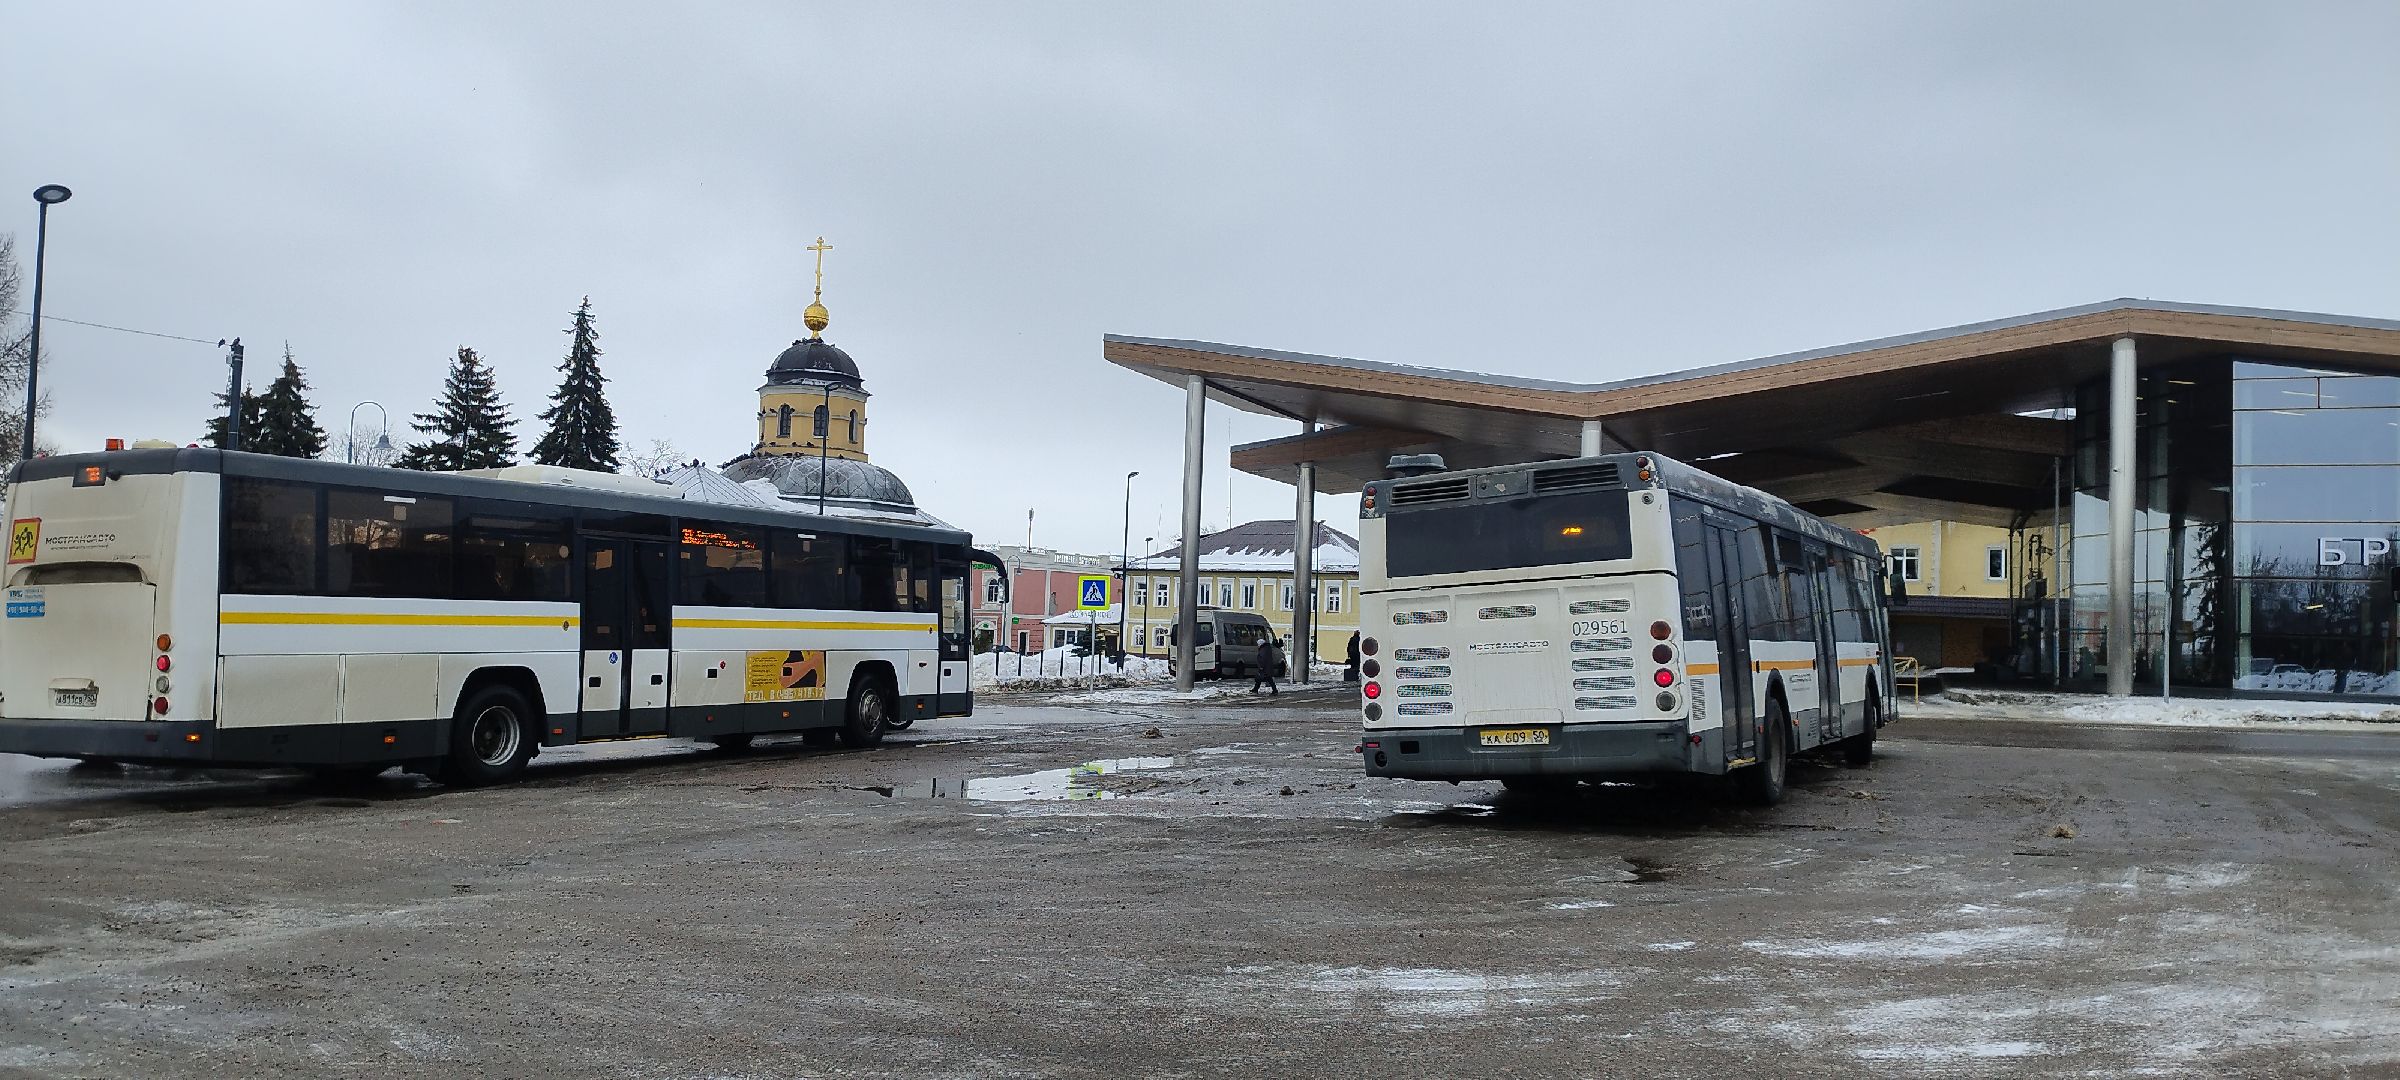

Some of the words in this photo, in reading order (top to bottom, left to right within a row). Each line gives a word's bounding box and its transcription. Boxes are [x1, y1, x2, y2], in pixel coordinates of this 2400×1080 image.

[45, 533, 116, 545] МОСТРАНСАВТО
[1572, 619, 1629, 637] 029561
[1469, 640, 1550, 652] МОСТРАНСАВТО
[1486, 734, 1501, 745] КА
[1504, 731, 1526, 744] 609
